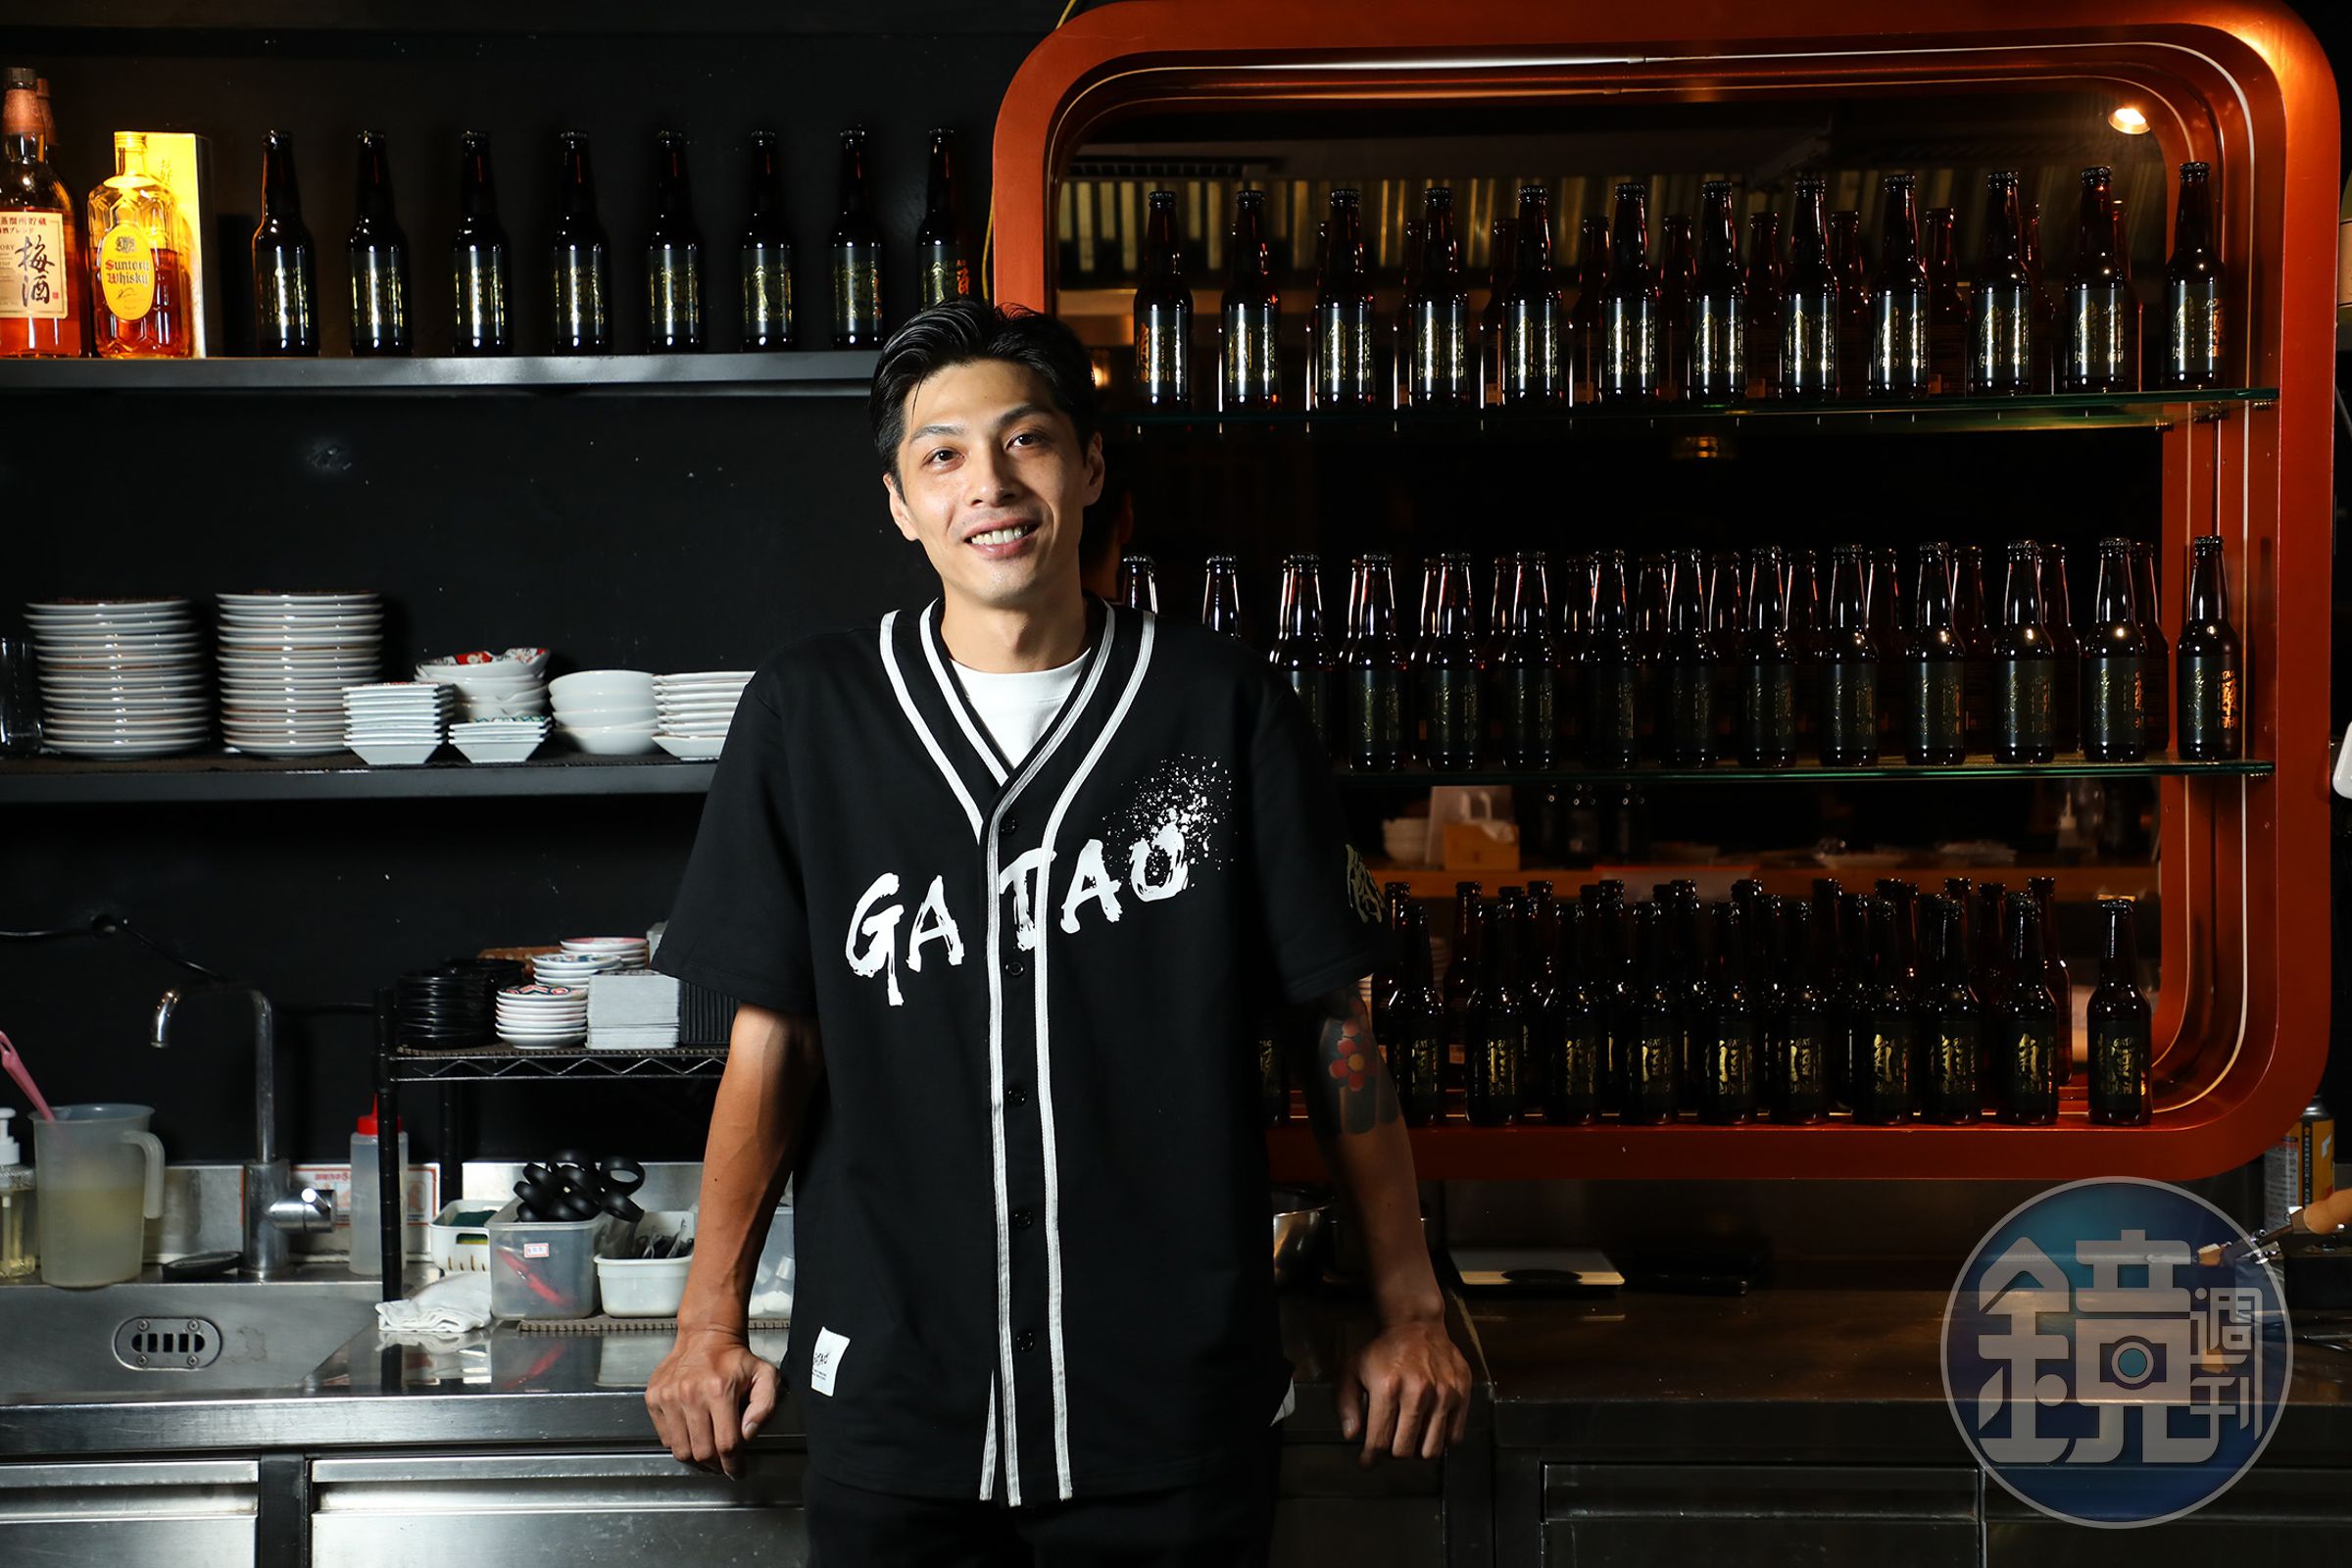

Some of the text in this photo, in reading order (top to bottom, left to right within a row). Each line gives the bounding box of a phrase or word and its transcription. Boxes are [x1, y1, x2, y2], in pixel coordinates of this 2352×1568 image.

[15, 234, 55, 307] 梅酒
[105, 259, 149, 271] Suntory
[107, 270, 149, 285] Whisky
[845, 819, 1190, 1006] GATAO
